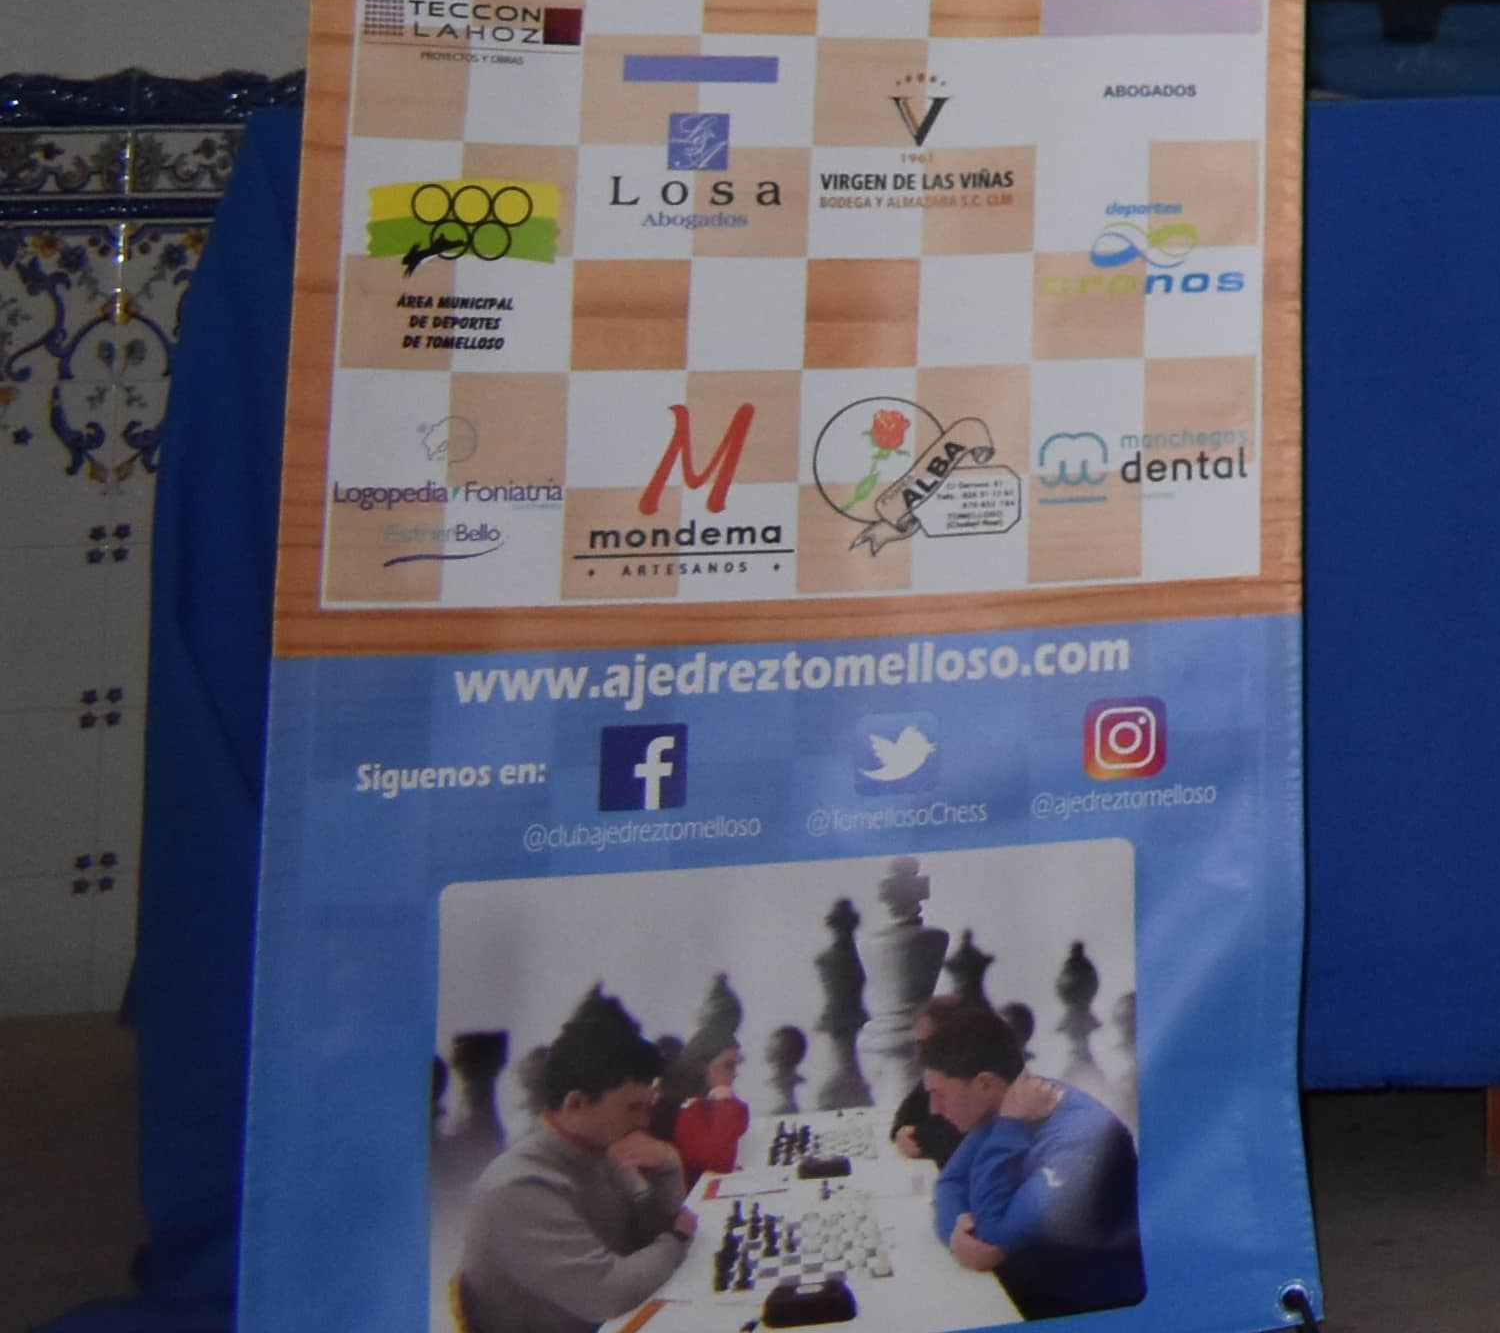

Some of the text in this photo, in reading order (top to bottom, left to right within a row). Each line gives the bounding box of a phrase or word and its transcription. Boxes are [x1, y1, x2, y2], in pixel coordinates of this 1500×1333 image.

[413, 23, 541, 45] LAHOZ
[1102, 83, 1198, 100] ABOGADOS
[609, 175, 782, 208] Losa
[820, 167, 1014, 192] VIRGEN DE LAS VIÑAS
[819, 196, 870, 210] BODEGA
[642, 210, 749, 230] Abogados
[436, 295, 515, 312] MUNICIPAL
[408, 314, 503, 331] DE DEPORTES
[402, 335, 505, 351] DE TOMELLOSO
[902, 441, 967, 511] ALBA
[1120, 446, 1249, 484] dental
[333, 479, 449, 512] Logopedia
[455, 523, 502, 543] Bello
[588, 519, 783, 550] mondema
[621, 560, 749, 577] ARTESANOS
[453, 637, 1131, 711] www.ajedreztomelloso.com
[498, 762, 547, 786] en:
[1030, 784, 1218, 821] @ajedreztomelloso
[806, 802, 989, 836] @TomellosoChess
[522, 816, 762, 853] @clubajedreztomelloso
